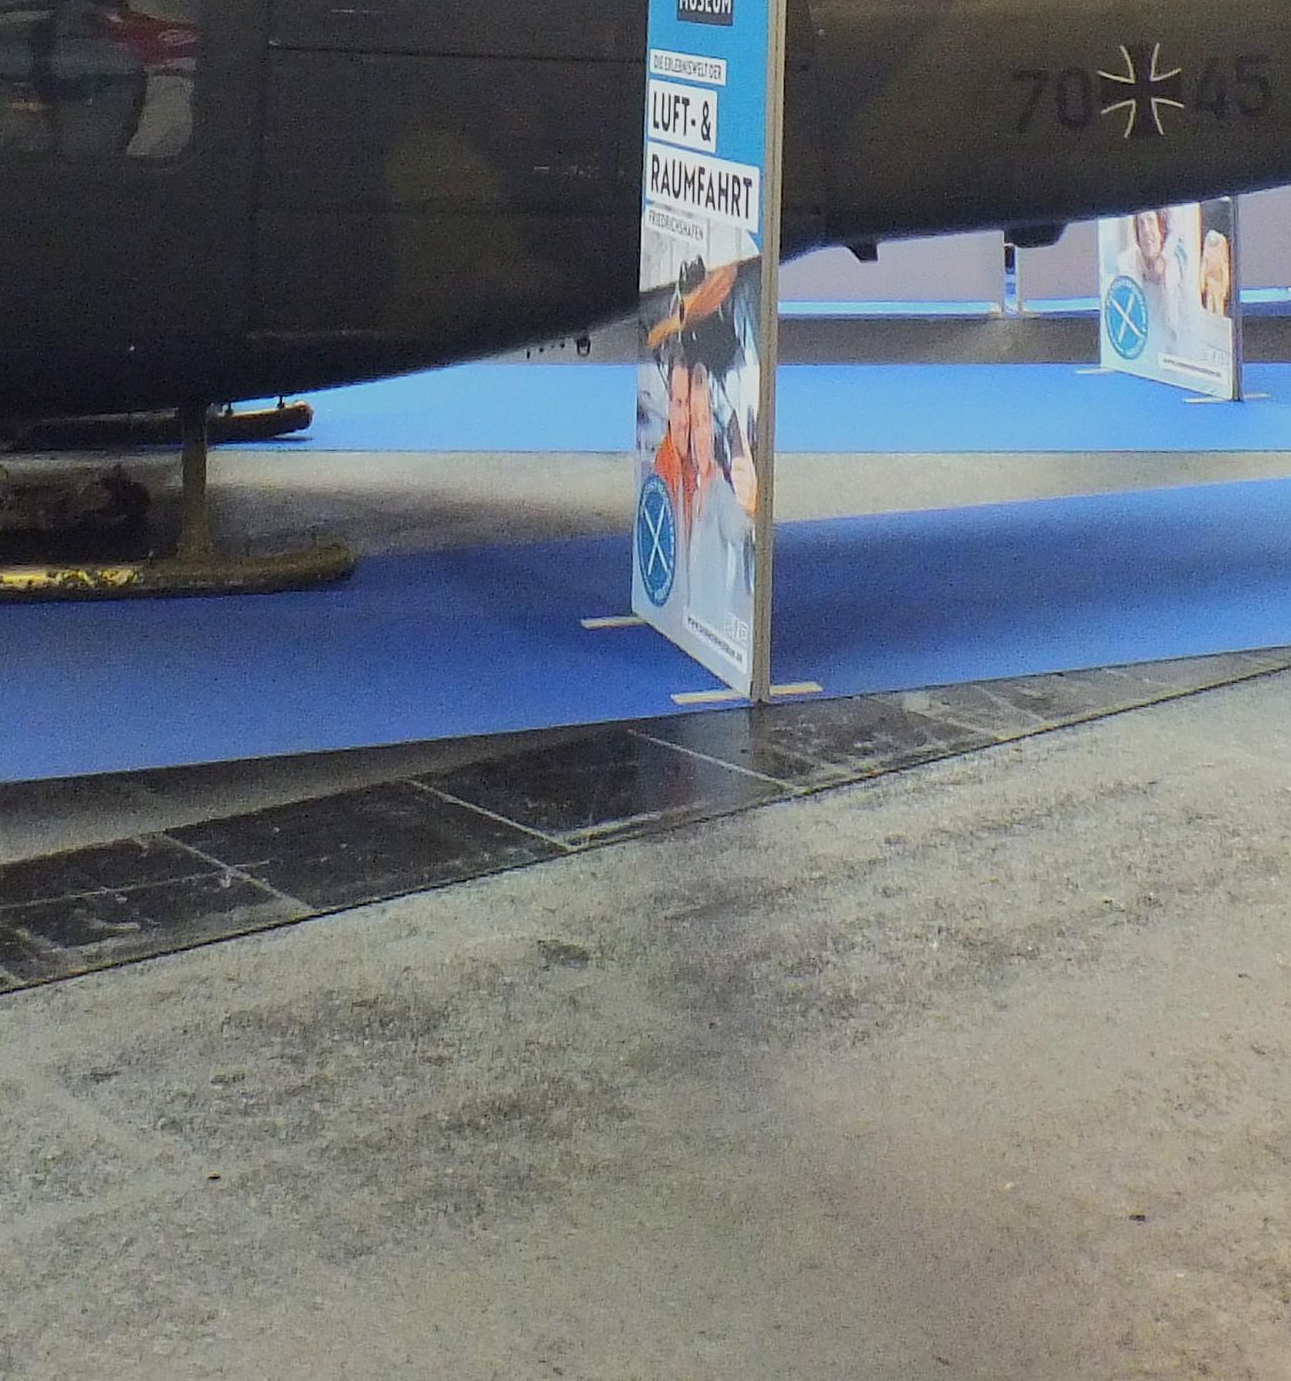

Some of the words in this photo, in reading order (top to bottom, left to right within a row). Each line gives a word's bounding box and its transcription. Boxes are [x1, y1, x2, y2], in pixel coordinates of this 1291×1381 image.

[652, 91, 696, 137] LUFT-
[701, 100, 711, 141] &
[1011, 67, 1092, 133] 70
[651, 154, 753, 219] RAUMFAHRT
